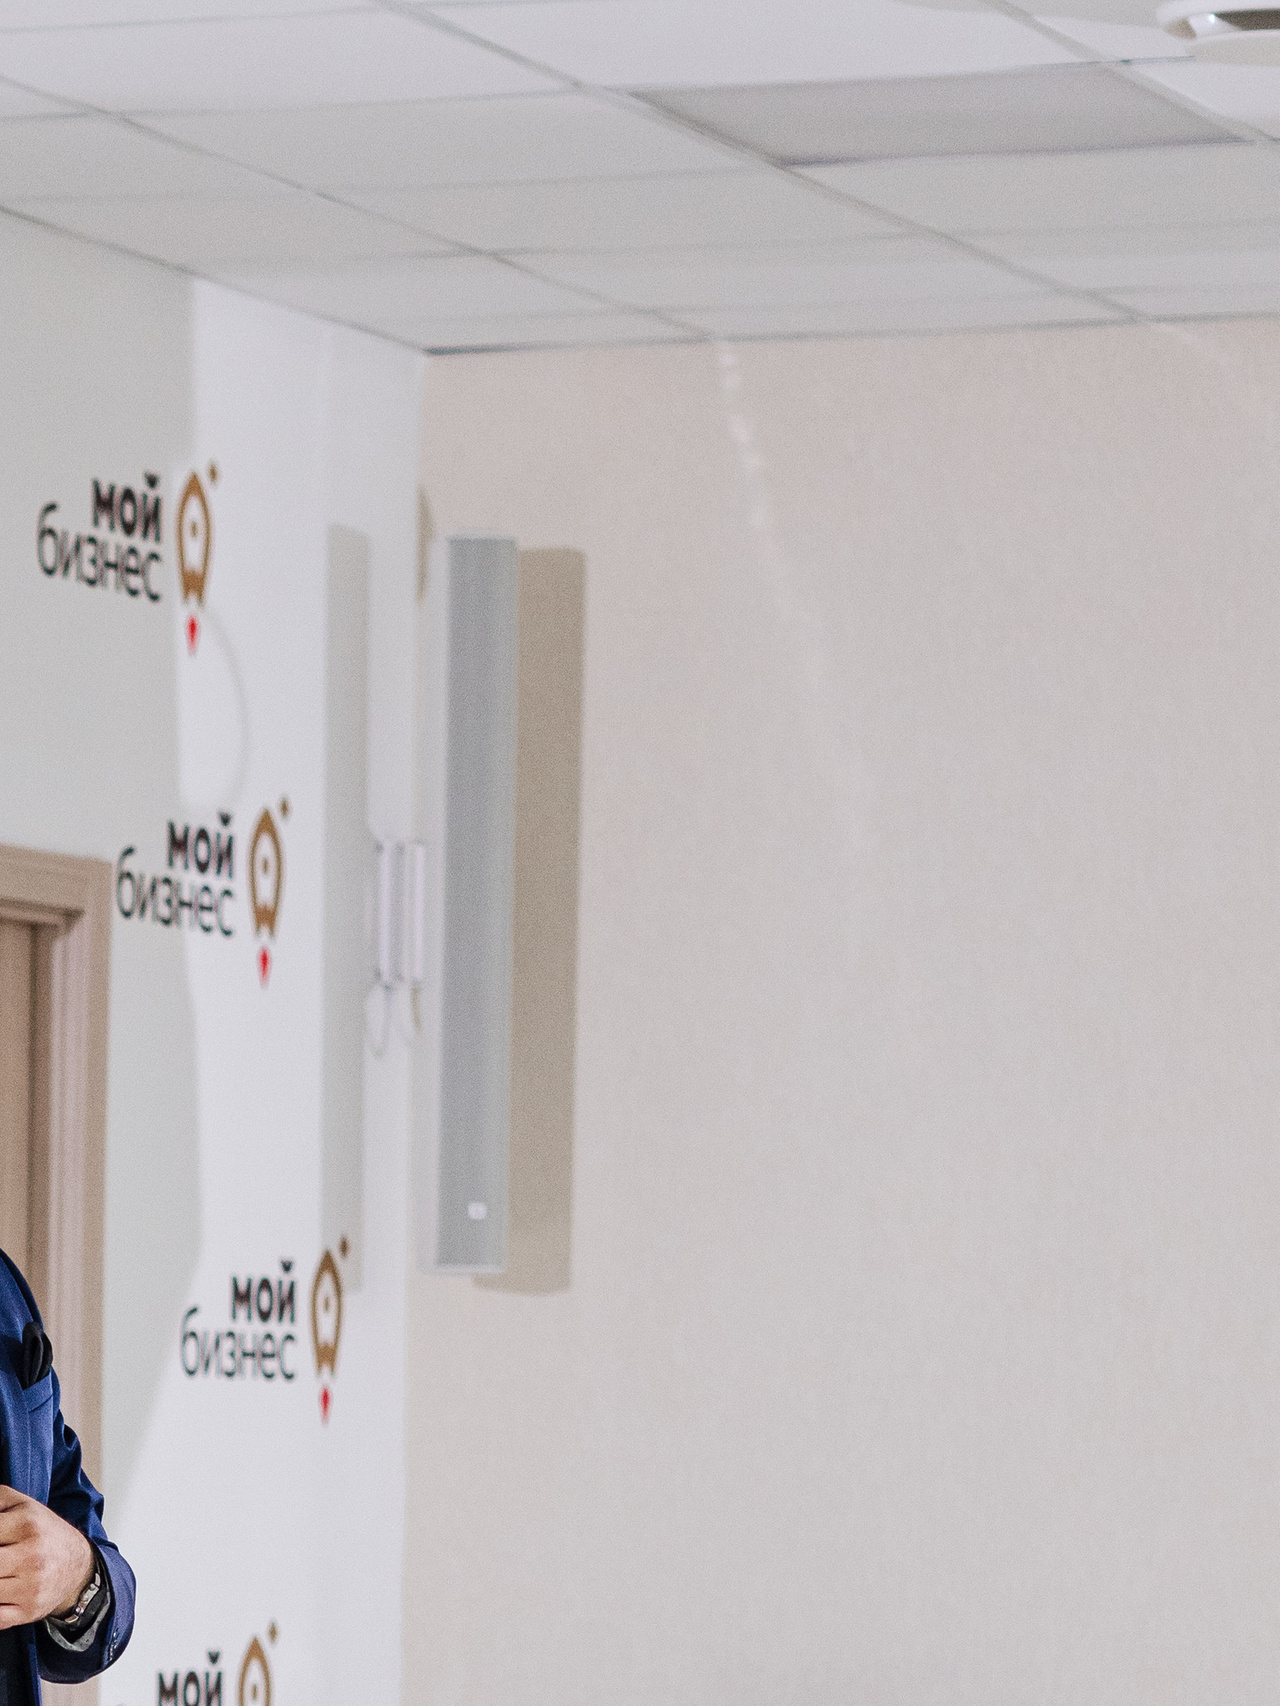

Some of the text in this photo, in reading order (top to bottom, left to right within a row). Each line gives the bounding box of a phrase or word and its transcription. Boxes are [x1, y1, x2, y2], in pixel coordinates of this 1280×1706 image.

[92, 473, 161, 543] мой
[37, 503, 161, 603] бизнес
[168, 812, 234, 875] мой
[117, 846, 235, 937] бизнес
[231, 1260, 296, 1324] мой
[180, 1306, 297, 1382] бизнес
